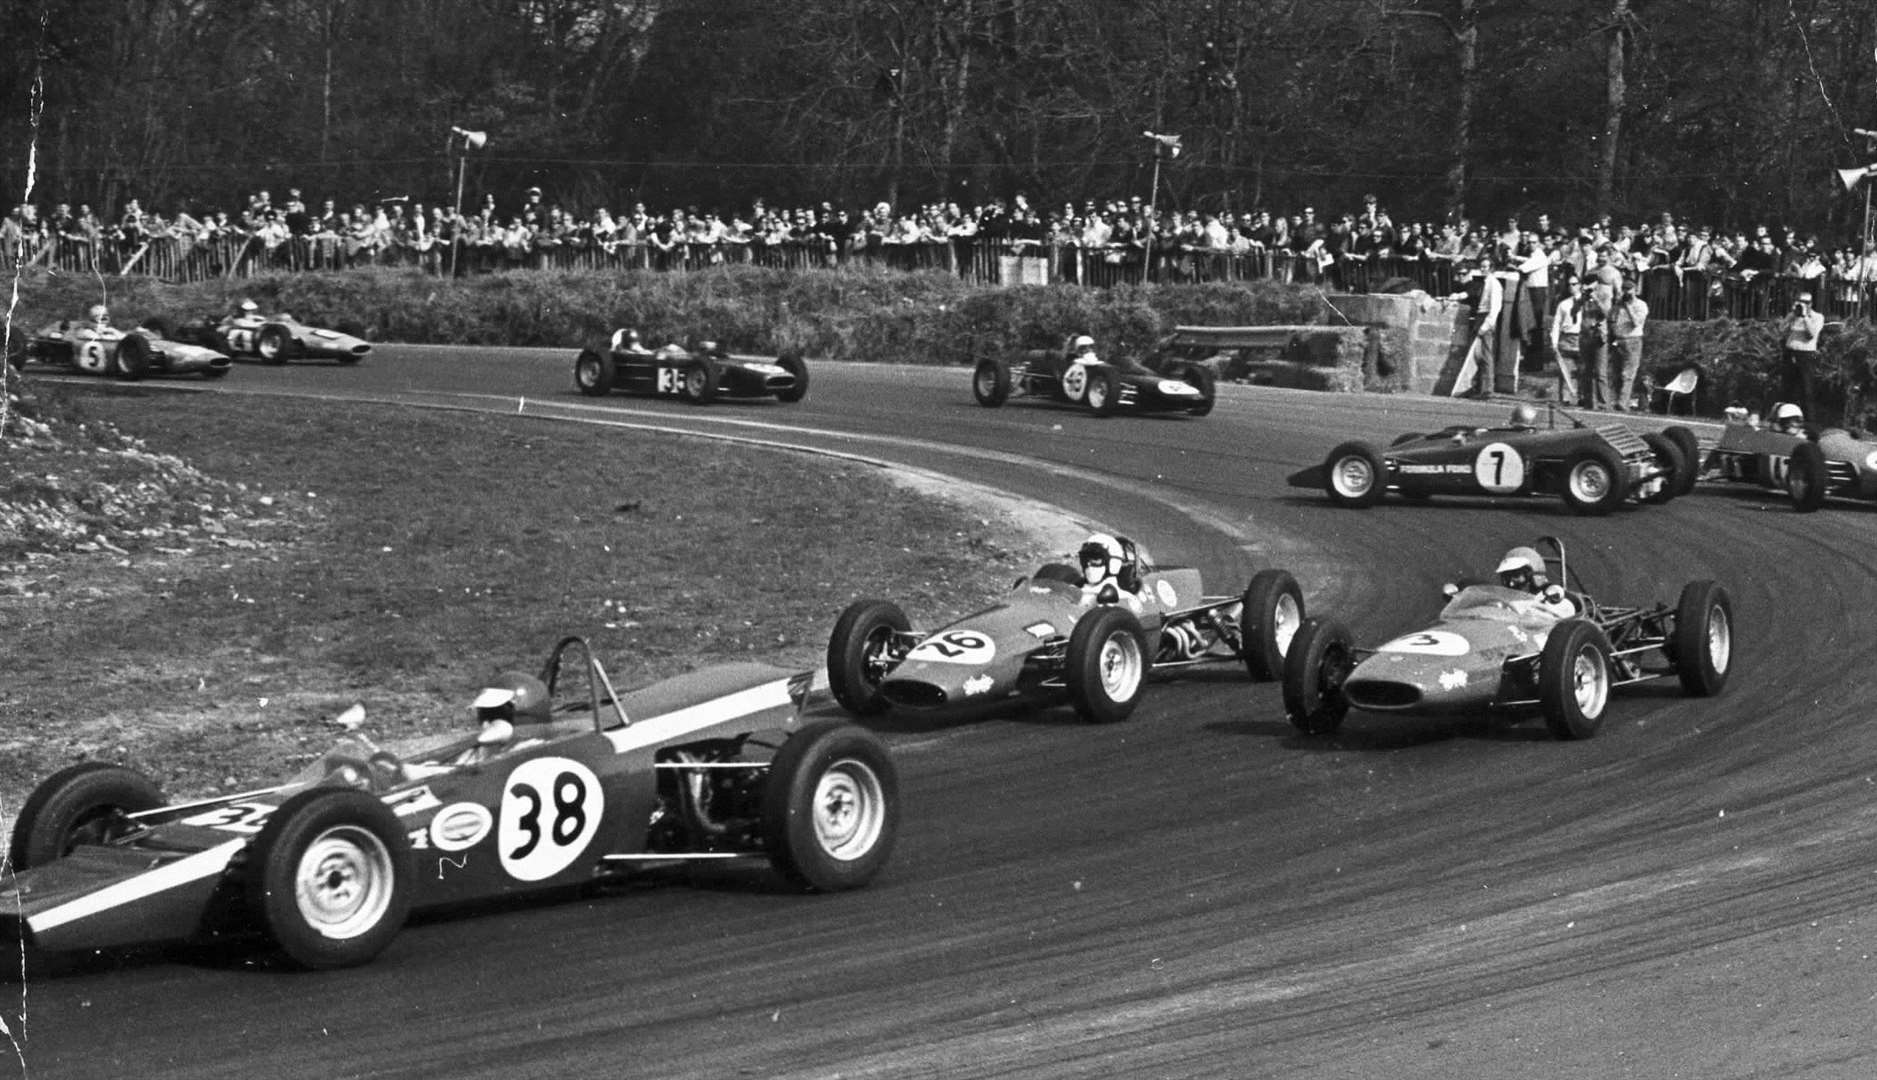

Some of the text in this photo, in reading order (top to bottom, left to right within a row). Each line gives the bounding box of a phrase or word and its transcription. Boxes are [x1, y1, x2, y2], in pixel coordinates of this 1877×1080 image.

[88, 345, 99, 367] 5
[1490, 451, 1504, 485] 7
[917, 631, 986, 657] 26
[1403, 634, 1440, 646] 3
[509, 771, 587, 860] 38
